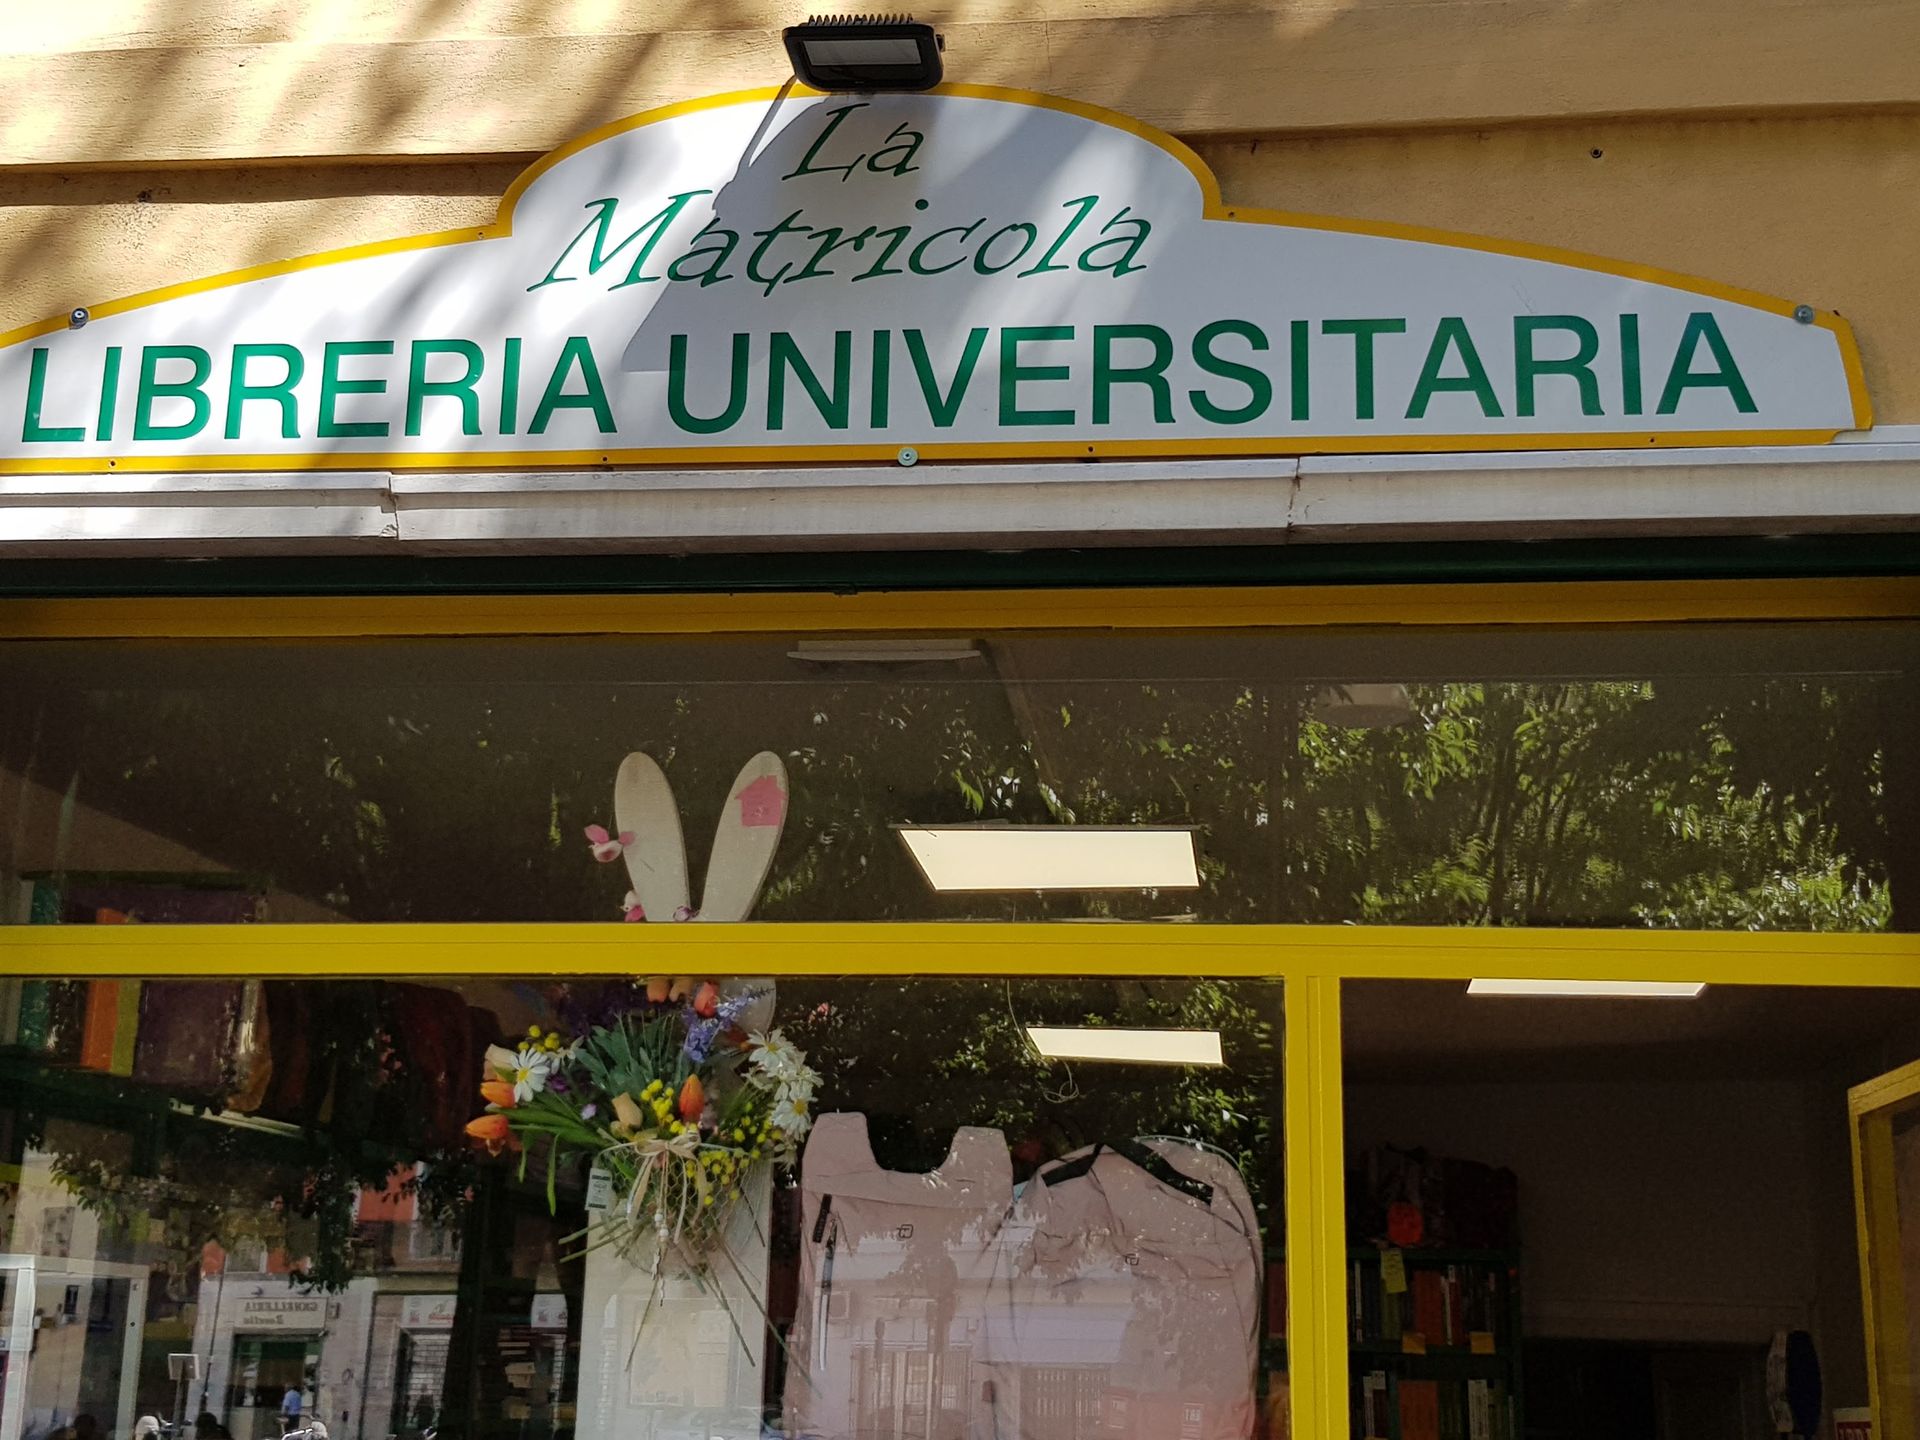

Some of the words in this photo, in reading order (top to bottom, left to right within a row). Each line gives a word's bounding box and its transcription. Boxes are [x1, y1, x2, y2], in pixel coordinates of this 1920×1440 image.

[782, 102, 926, 183] La
[526, 188, 1154, 298] Matricola
[21, 336, 616, 444] LIBRERIA
[666, 312, 1757, 435] UNIVERSITARIA
